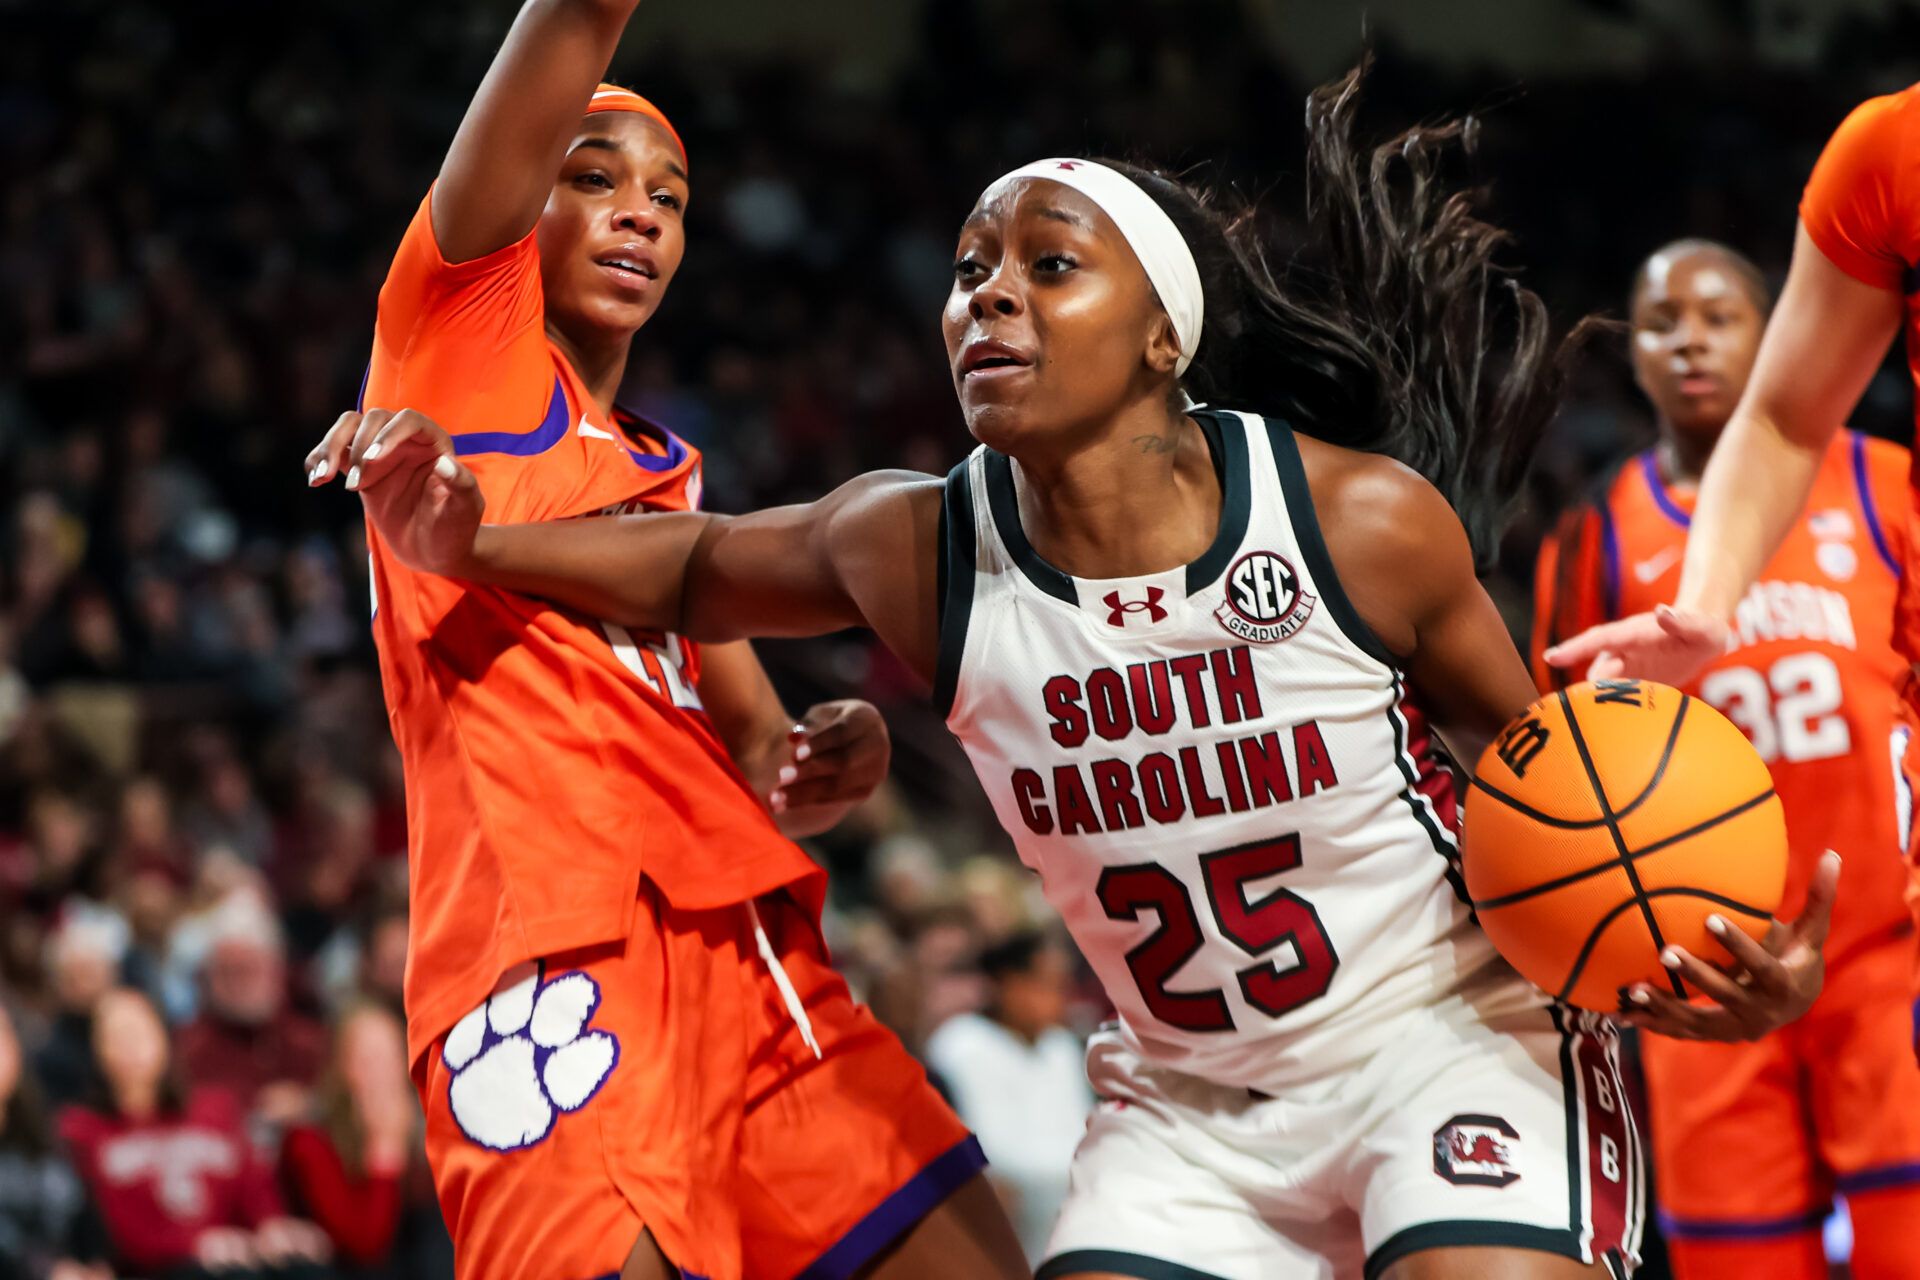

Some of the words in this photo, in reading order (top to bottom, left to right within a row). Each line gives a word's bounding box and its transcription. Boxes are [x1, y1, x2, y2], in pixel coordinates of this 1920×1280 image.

[1229, 609, 1307, 641] GRADUATE
[1232, 555, 1295, 619] SEC
[1042, 645, 1264, 748] SOUTH
[1701, 652, 1851, 764] 32
[1011, 719, 1338, 836] CAROLINA
[1096, 831, 1340, 1033] 25
